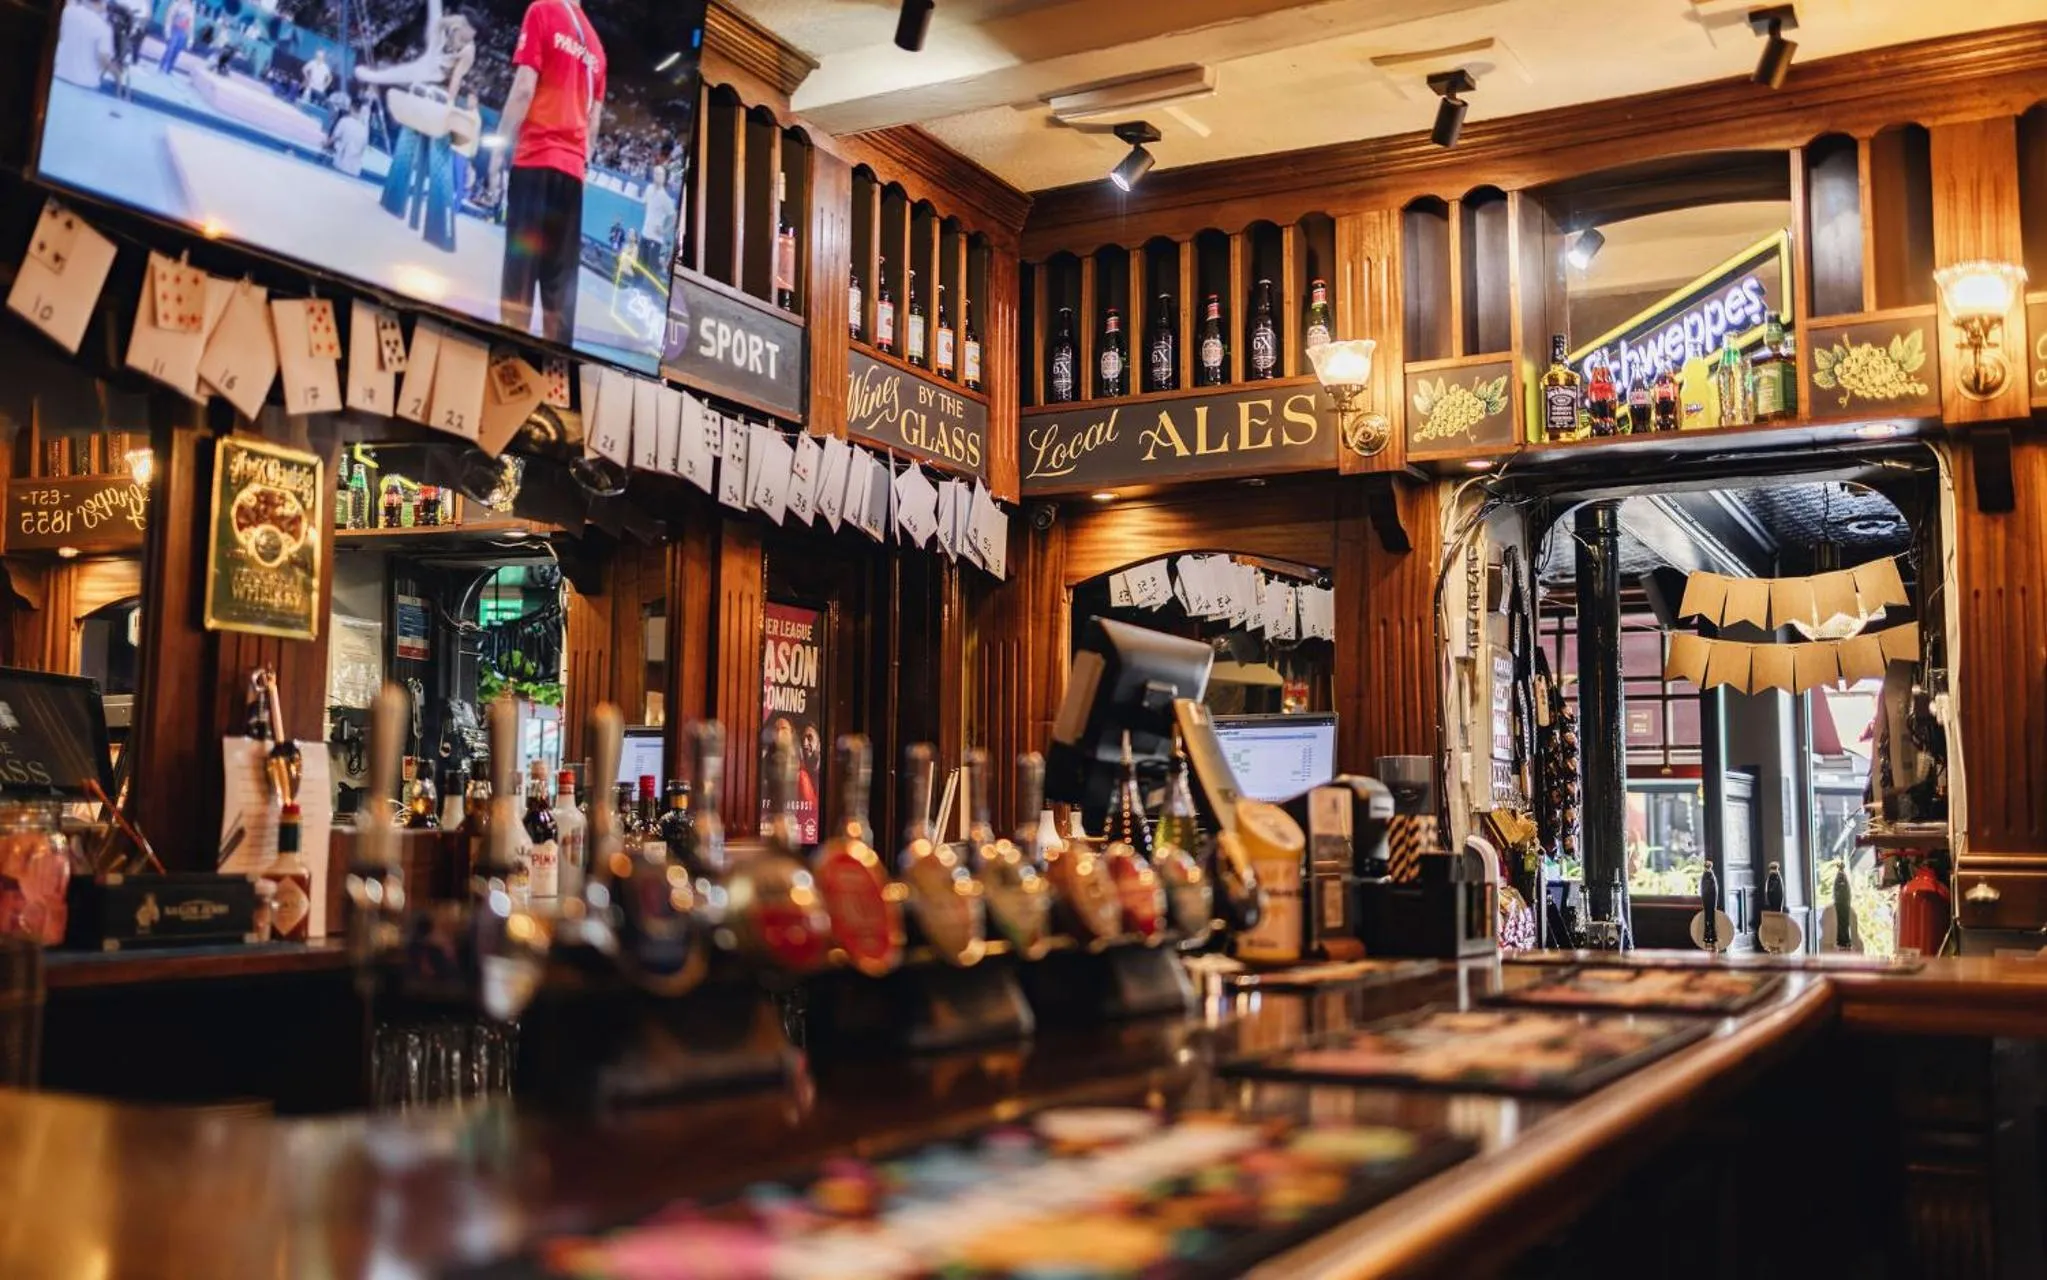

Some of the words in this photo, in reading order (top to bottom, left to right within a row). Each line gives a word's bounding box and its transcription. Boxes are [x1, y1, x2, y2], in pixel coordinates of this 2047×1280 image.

[32, 294, 55, 322] 10
[698, 316, 780, 379] SPORT
[151, 358, 166, 376] 11
[846, 364, 900, 431] Wines
[919, 385, 936, 408] BY
[938, 393, 964, 418] THE
[445, 409, 465, 430] 22
[900, 408, 981, 467] GLASS
[1025, 408, 1120, 480] Local
[1138, 394, 1318, 461] ALES
[794, 491, 807, 513] 38
[780, 619, 813, 642] LEAGUE
